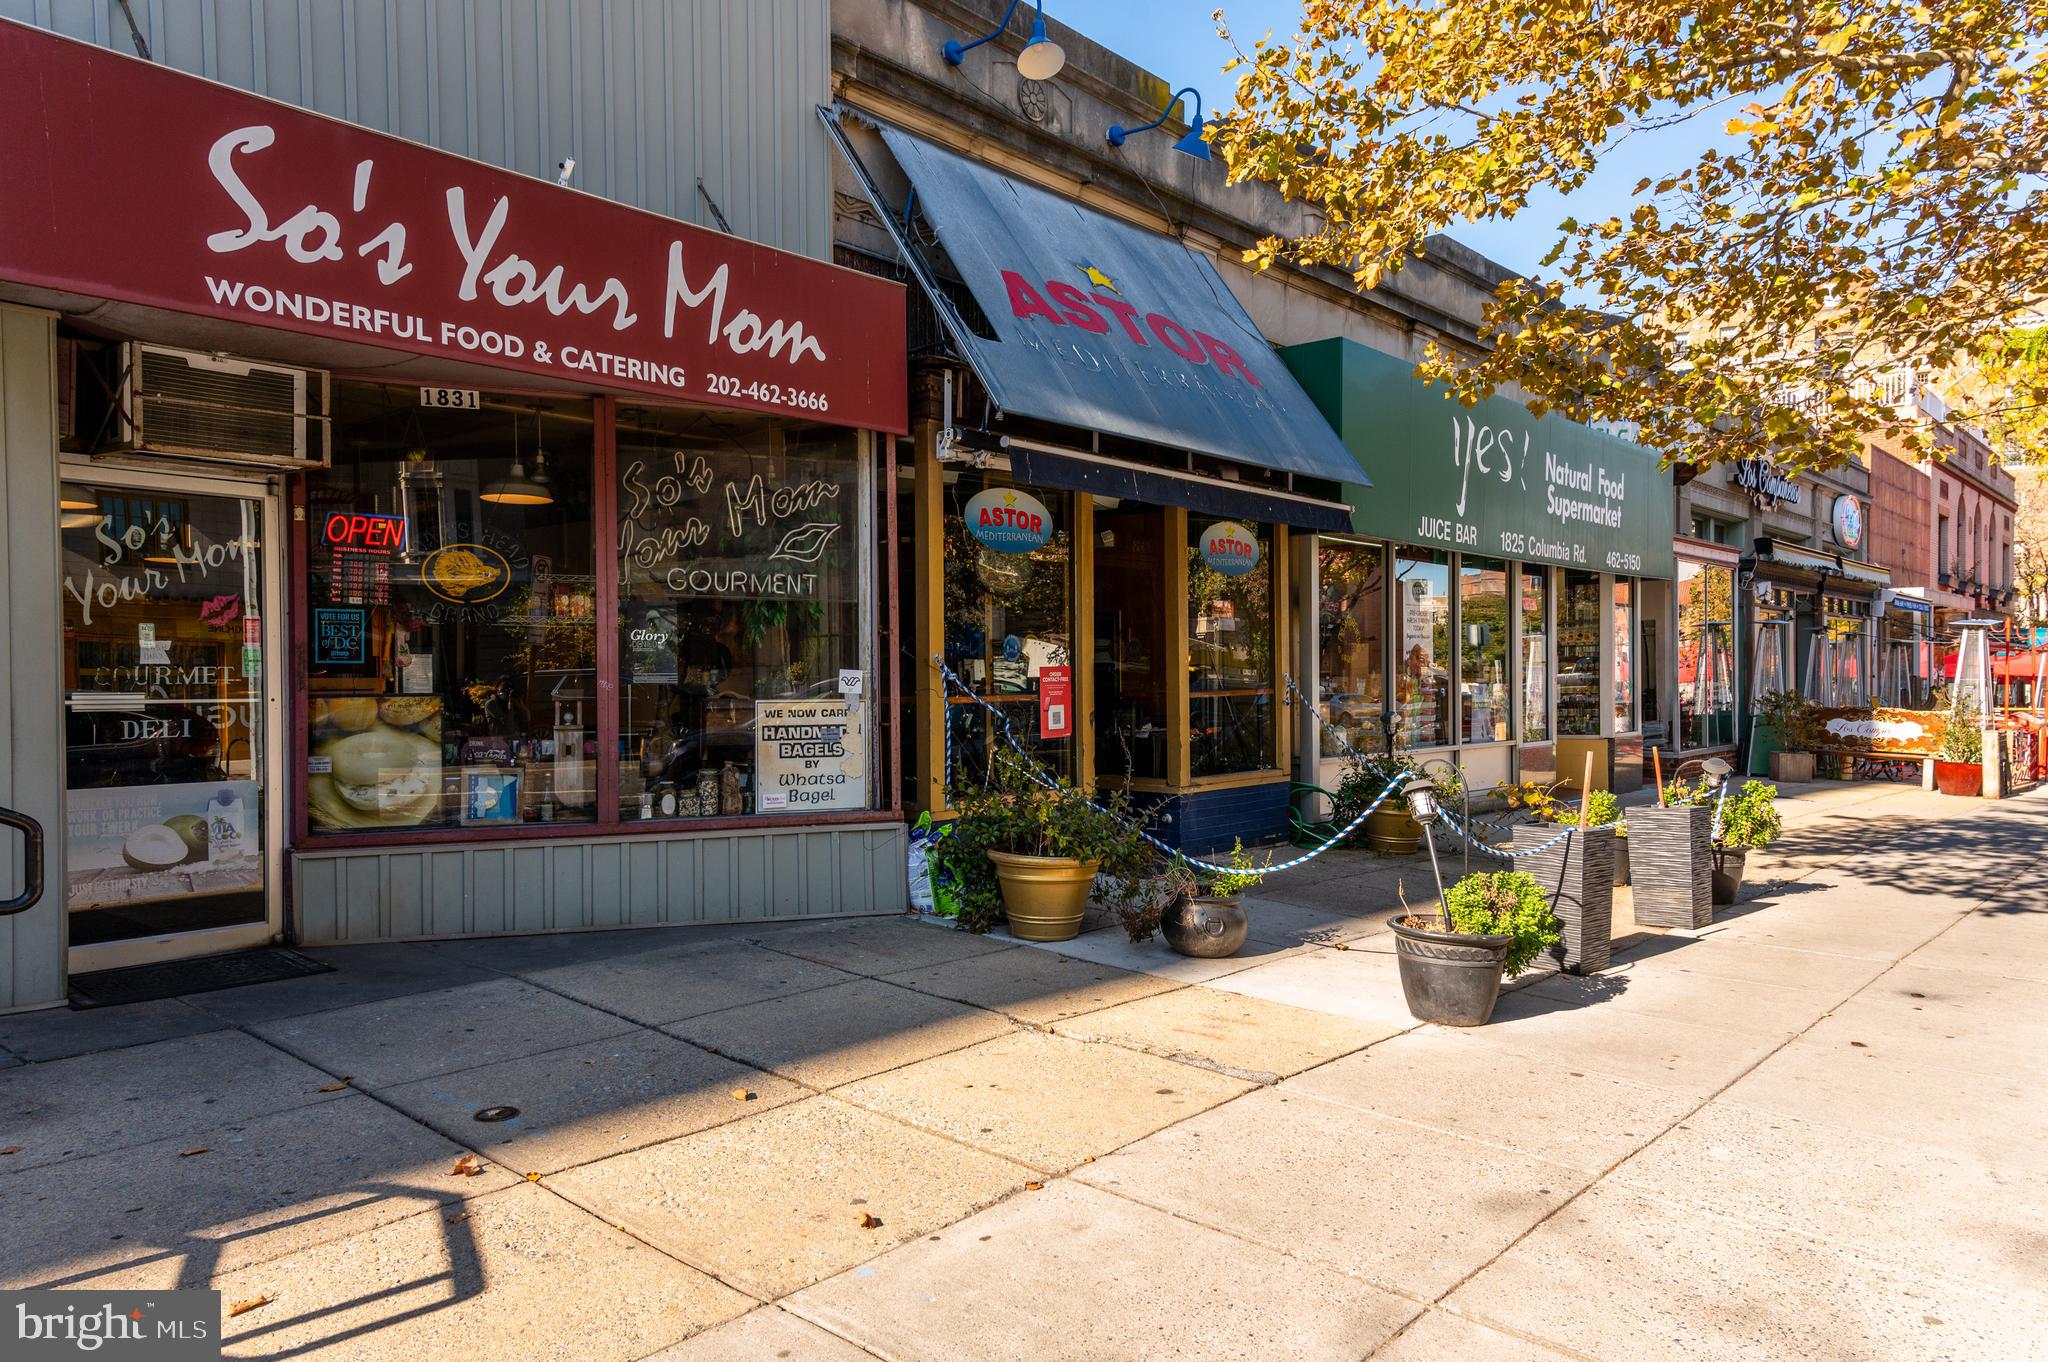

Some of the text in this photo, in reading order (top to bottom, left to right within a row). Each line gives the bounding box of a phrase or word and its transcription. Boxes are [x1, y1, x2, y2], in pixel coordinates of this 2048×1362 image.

[206, 125, 826, 364] So's Your Mom
[1001, 269, 1264, 389] ASTOR
[204, 276, 829, 412] WONDERFUL FOOD & CATERING 202-462-3666
[424, 389, 478, 408] 1831
[1545, 452, 1625, 501] Natural Food
[1738, 458, 1757, 489] Los
[623, 451, 840, 537] So's Mom
[1547, 484, 1622, 528] Supermarket
[327, 514, 404, 547] OPEN
[979, 507, 1042, 535] ASTOR
[96, 510, 175, 567] So's
[975, 529, 1044, 543] MEDITERRANEAN
[1418, 516, 1641, 571] JUICE BAR 1825 Columbia Rd. 462-5150
[617, 517, 710, 585] Your
[1209, 538, 1253, 558] ASTOR
[667, 568, 816, 595] GOURMENT
[64, 568, 169, 625] Your
[320, 612, 336, 620] VOTE
[321, 624, 360, 636] BEST
[630, 629, 668, 644] Glory
[321, 637, 331, 649] of
[94, 665, 235, 686] GOURMET
[764, 710, 783, 718] WE
[788, 709, 816, 718] NOW
[121, 718, 192, 740] DELI
[780, 742, 845, 759] BAGELS
[805, 760, 819, 768] BY
[779, 773, 846, 787] Whatsa
[789, 788, 836, 804] Bagel
[68, 806, 161, 823] WORK OR PRACTICE
[68, 823, 96, 836] YOUR
[211, 822, 236, 833] VITA
[69, 882, 93, 897] JUST
